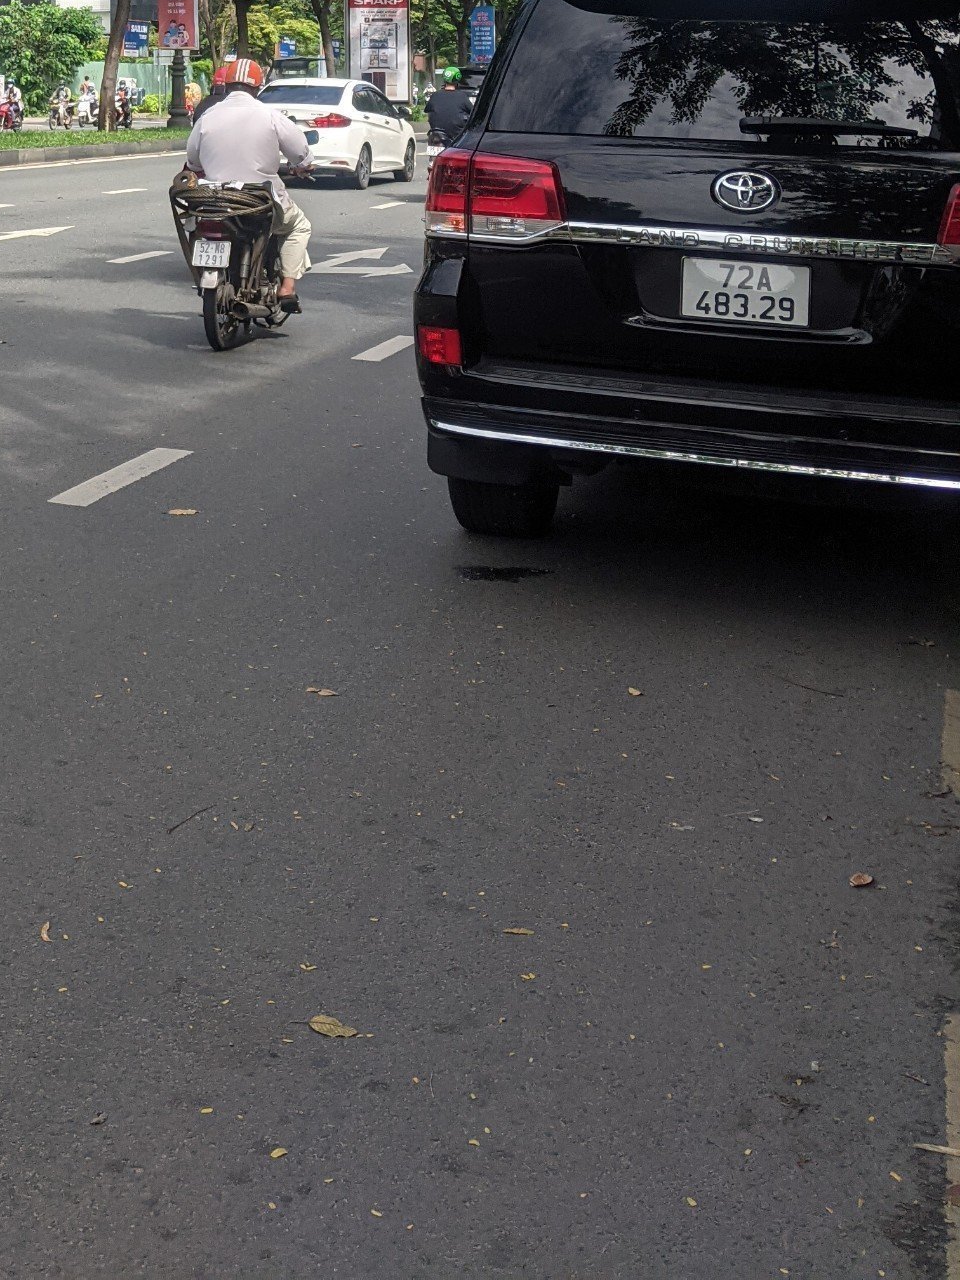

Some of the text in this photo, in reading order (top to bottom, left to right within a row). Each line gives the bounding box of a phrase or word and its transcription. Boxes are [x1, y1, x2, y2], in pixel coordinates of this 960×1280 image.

[616, 227, 700, 247] LAND
[198, 254, 223, 266] 1291
[718, 263, 772, 292] 72A
[695, 290, 796, 322] 483.29
